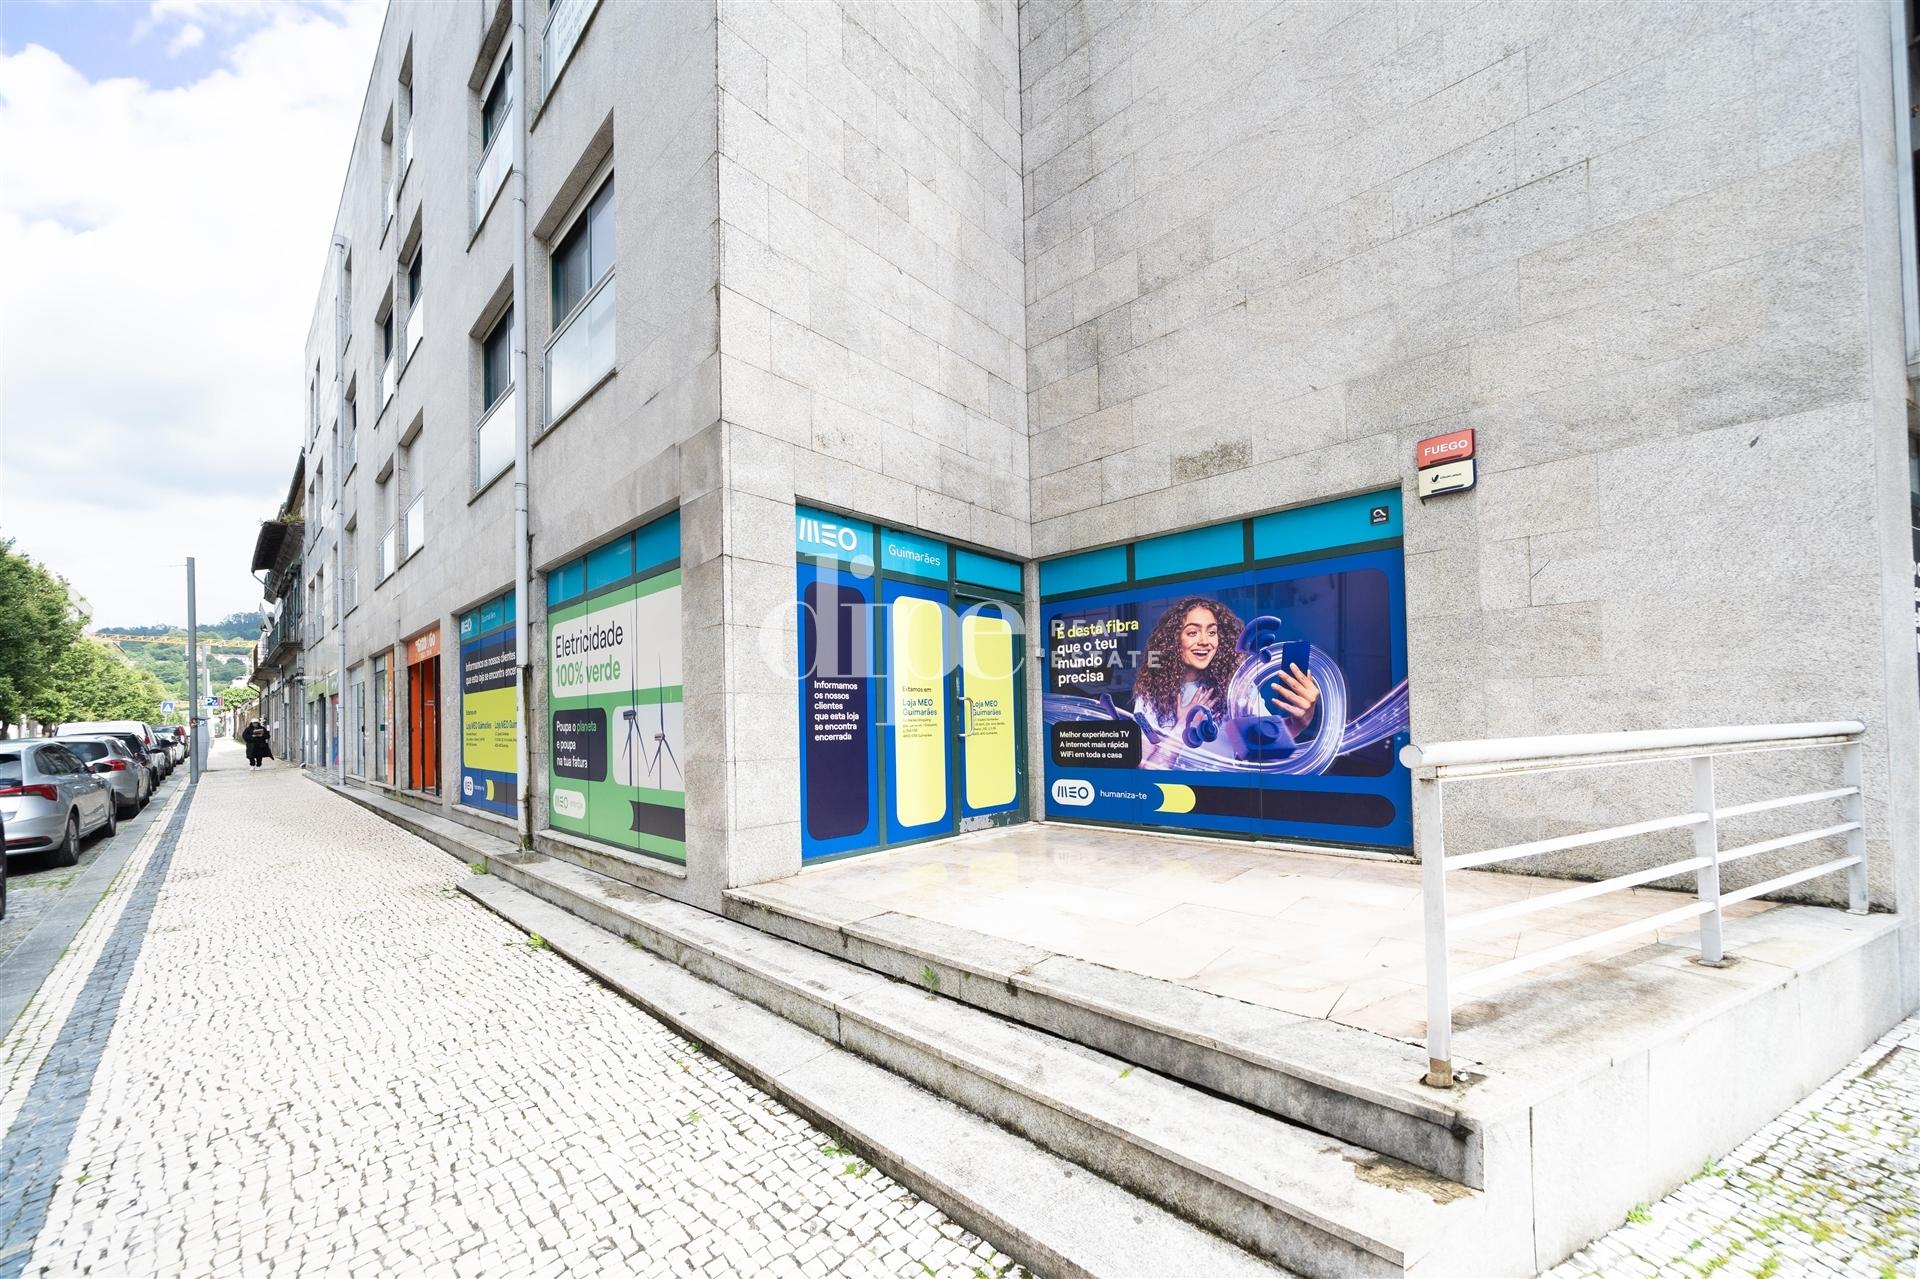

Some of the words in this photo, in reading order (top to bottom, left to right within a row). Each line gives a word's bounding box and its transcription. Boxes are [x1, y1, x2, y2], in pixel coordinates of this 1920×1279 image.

[1424, 439, 1468, 456] FUEGO
[799, 518, 858, 551] MEO
[888, 544, 941, 566] Guimarães
[1067, 623, 1103, 638] desta
[1106, 619, 1139, 634] fibra
[556, 620, 624, 659] Eletricidade
[1057, 642, 1080, 656] que
[1083, 642, 1092, 652] o
[1095, 639, 1118, 650] teu
[1057, 653, 1103, 669] mundo
[556, 660, 584, 687] 100%
[586, 654, 621, 683] verde
[1058, 670, 1104, 687] precisa
[814, 680, 858, 690] Informamos
[824, 692, 850, 700] nossos
[814, 701, 843, 710] clientes
[902, 698, 917, 708] Loja
[917, 698, 934, 707] MEO
[984, 700, 998, 708] MEO
[814, 713, 829, 722] que
[830, 712, 846, 720] esta
[846, 711, 860, 722] loja
[902, 707, 938, 716] Guimarães
[556, 721, 571, 734] Poupa
[572, 723, 576, 732] o
[576, 720, 597, 735] planeta
[824, 722, 858, 731] encontra
[814, 732, 852, 741] encerrada
[1082, 730, 1119, 739] experiência
[1120, 730, 1130, 738] TV
[556, 740, 560, 749] e
[560, 740, 576, 752] poupa
[1107, 741, 1129, 749] rápida
[556, 757, 563, 766] na
[563, 756, 571, 767] tua
[572, 755, 588, 768] fatura
[1057, 785, 1089, 800] MEO
[1100, 789, 1148, 800] humaniza-te
